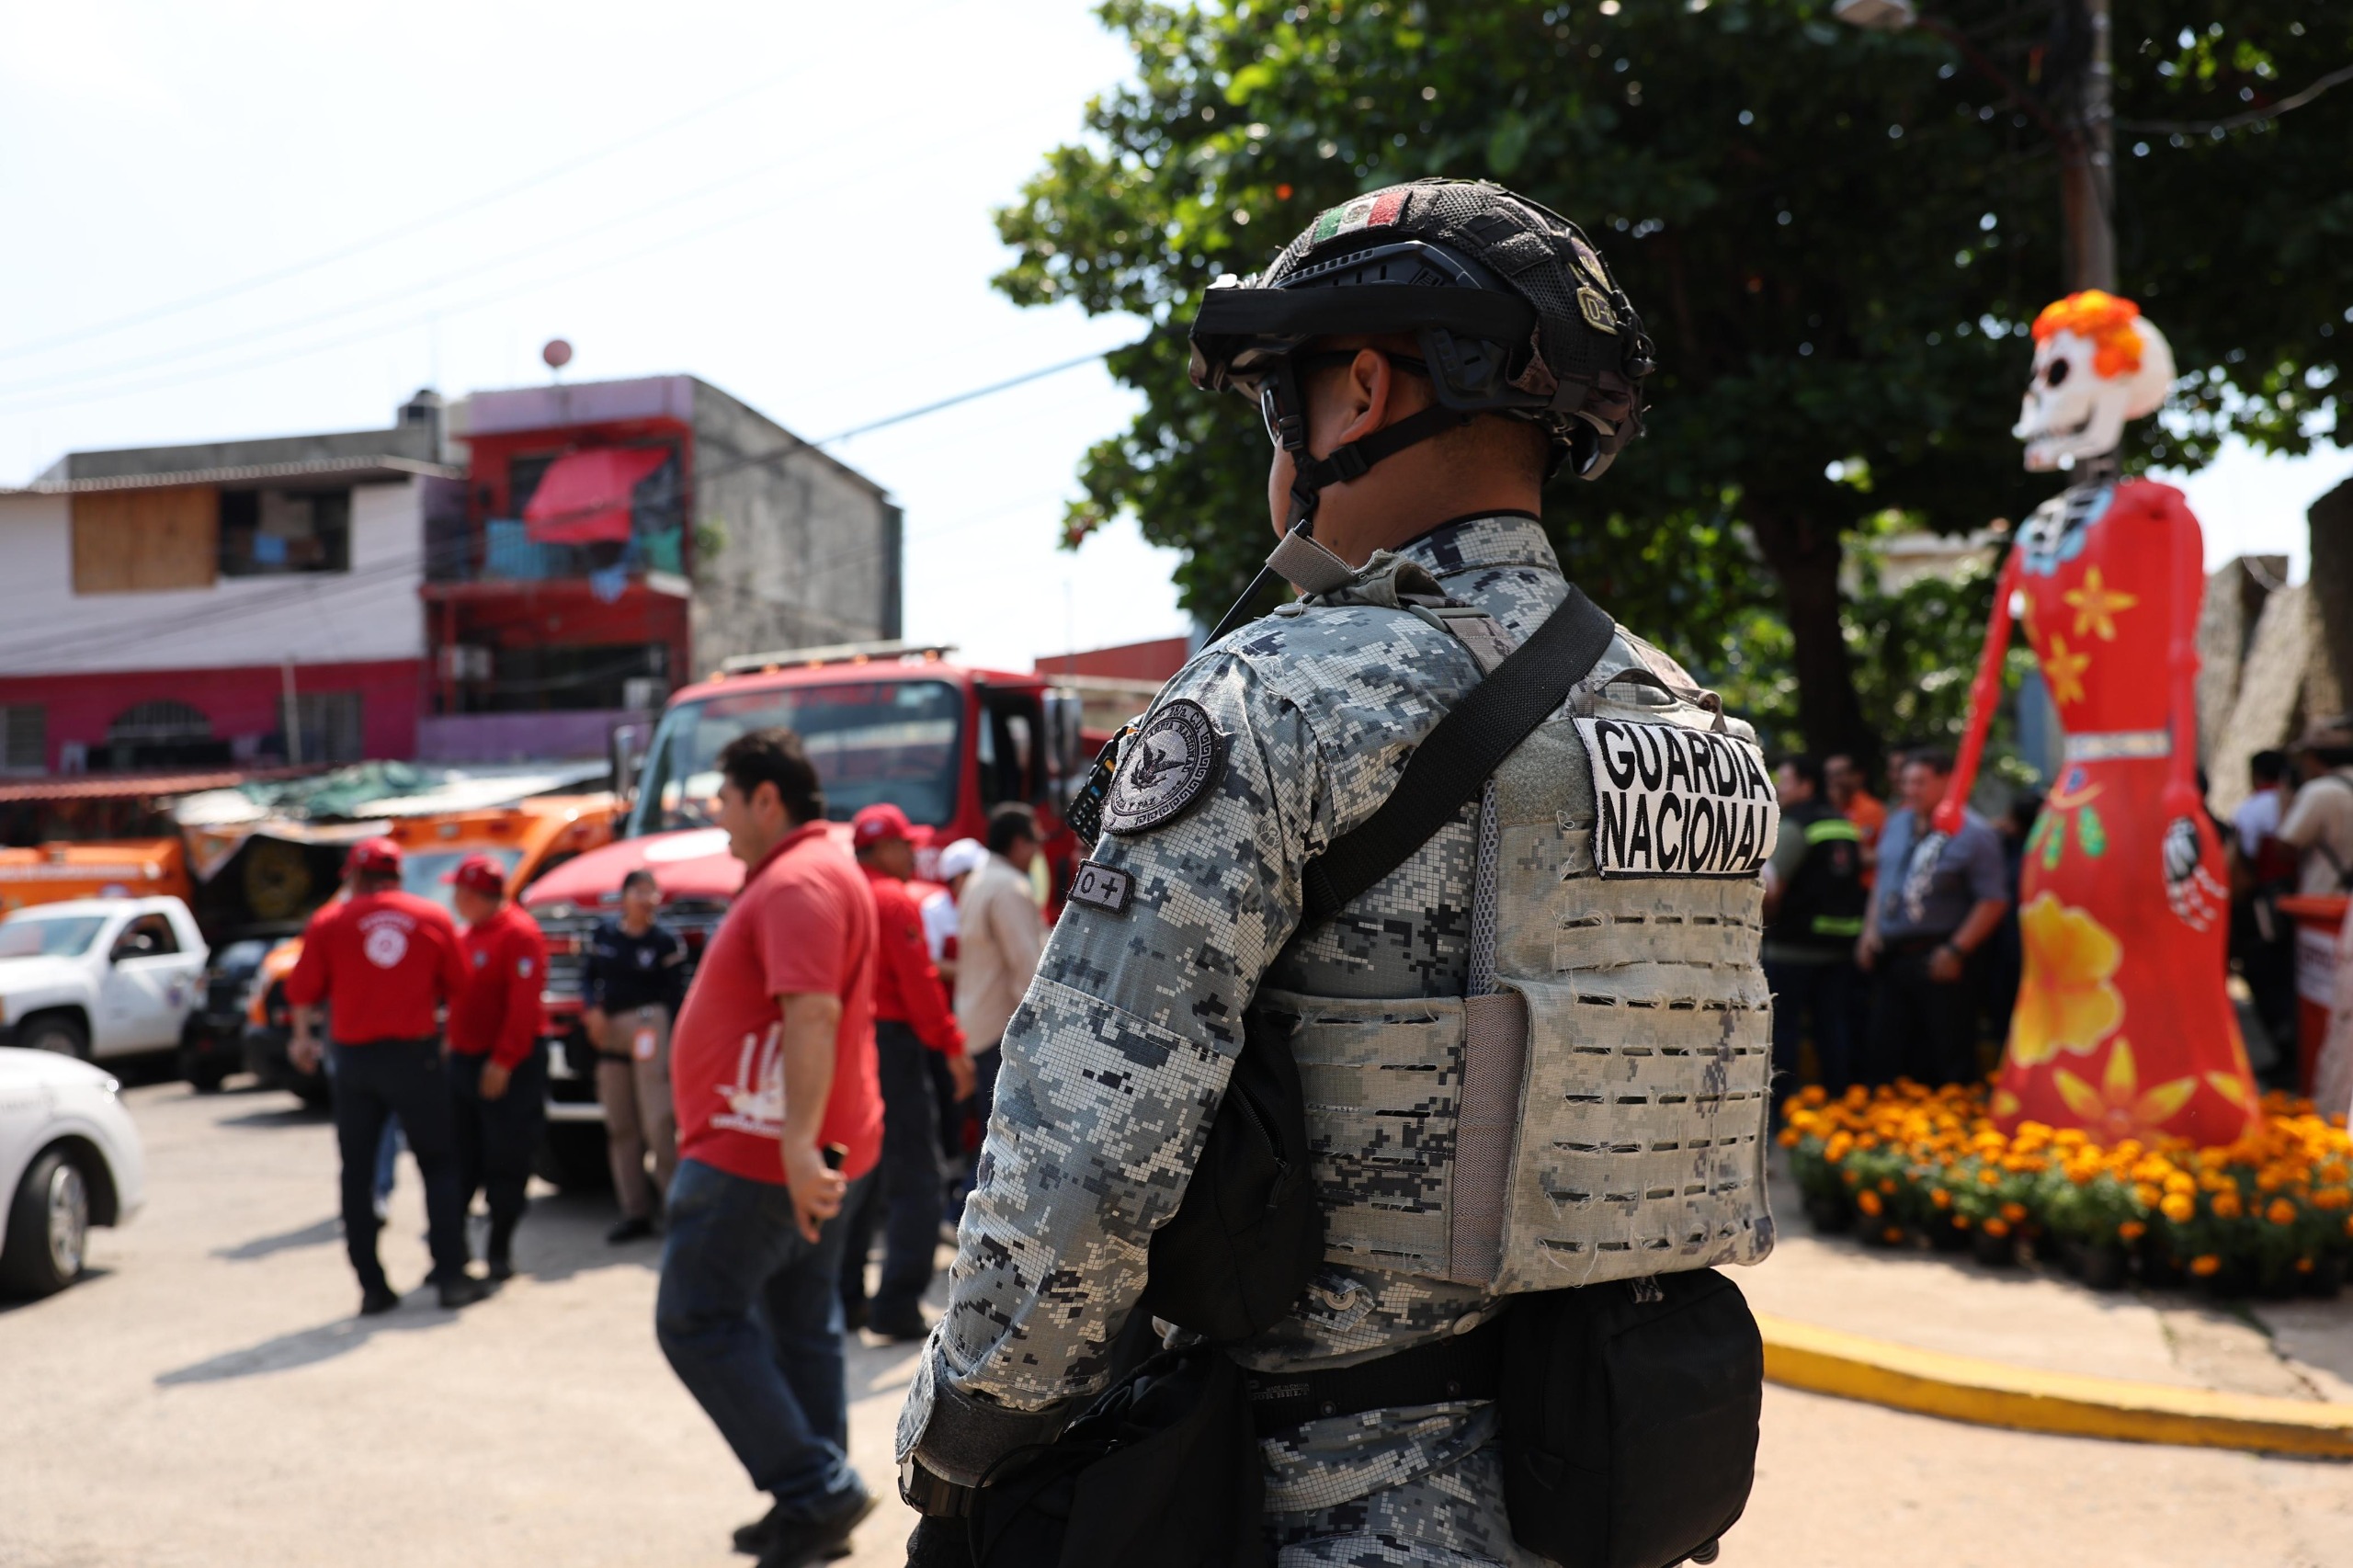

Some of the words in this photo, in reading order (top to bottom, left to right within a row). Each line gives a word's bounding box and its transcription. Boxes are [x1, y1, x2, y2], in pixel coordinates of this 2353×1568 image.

[1595, 720, 1772, 801] GUARDIA
[1602, 791, 1767, 872] NACIONAL
[1277, 1389, 1310, 1398] BELT
